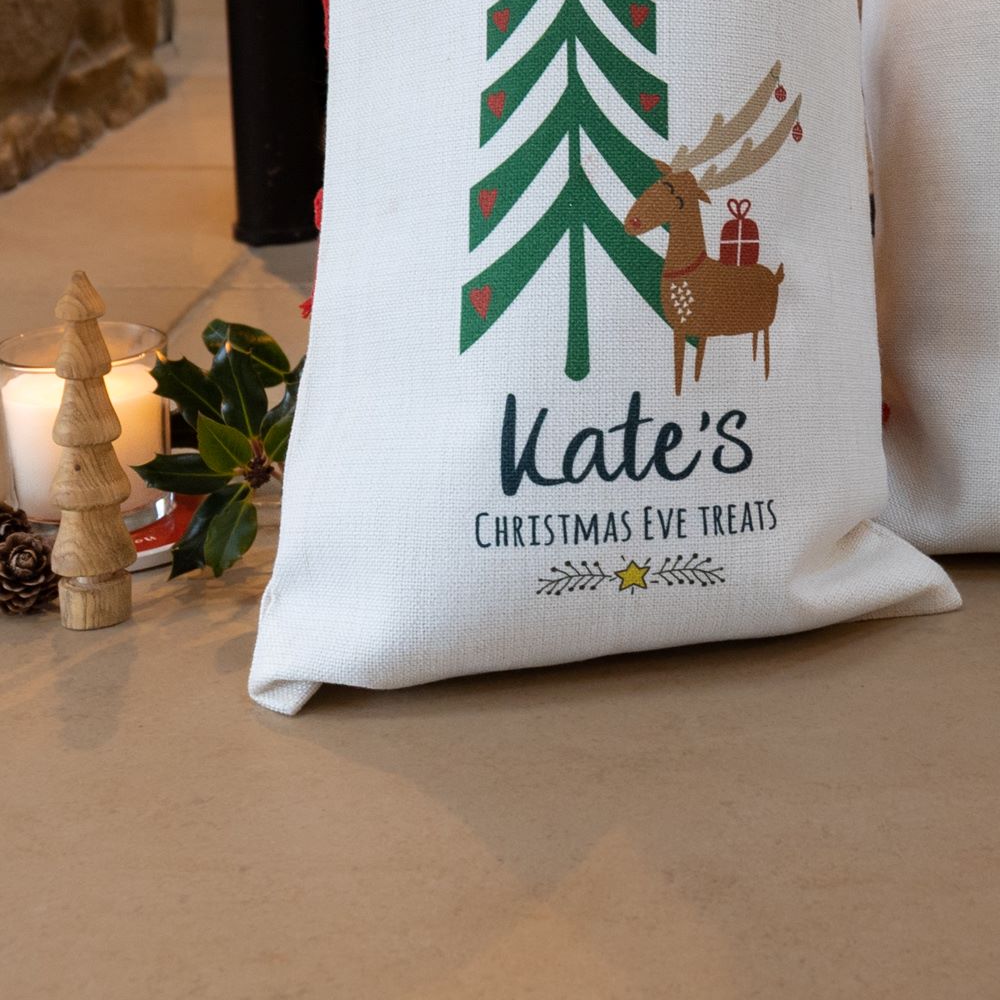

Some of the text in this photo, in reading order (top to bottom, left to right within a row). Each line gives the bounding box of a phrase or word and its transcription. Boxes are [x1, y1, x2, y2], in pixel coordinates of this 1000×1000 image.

[500, 390, 754, 497] Kate's
[475, 499, 778, 549] CHRISTMAS EVE TREATS
